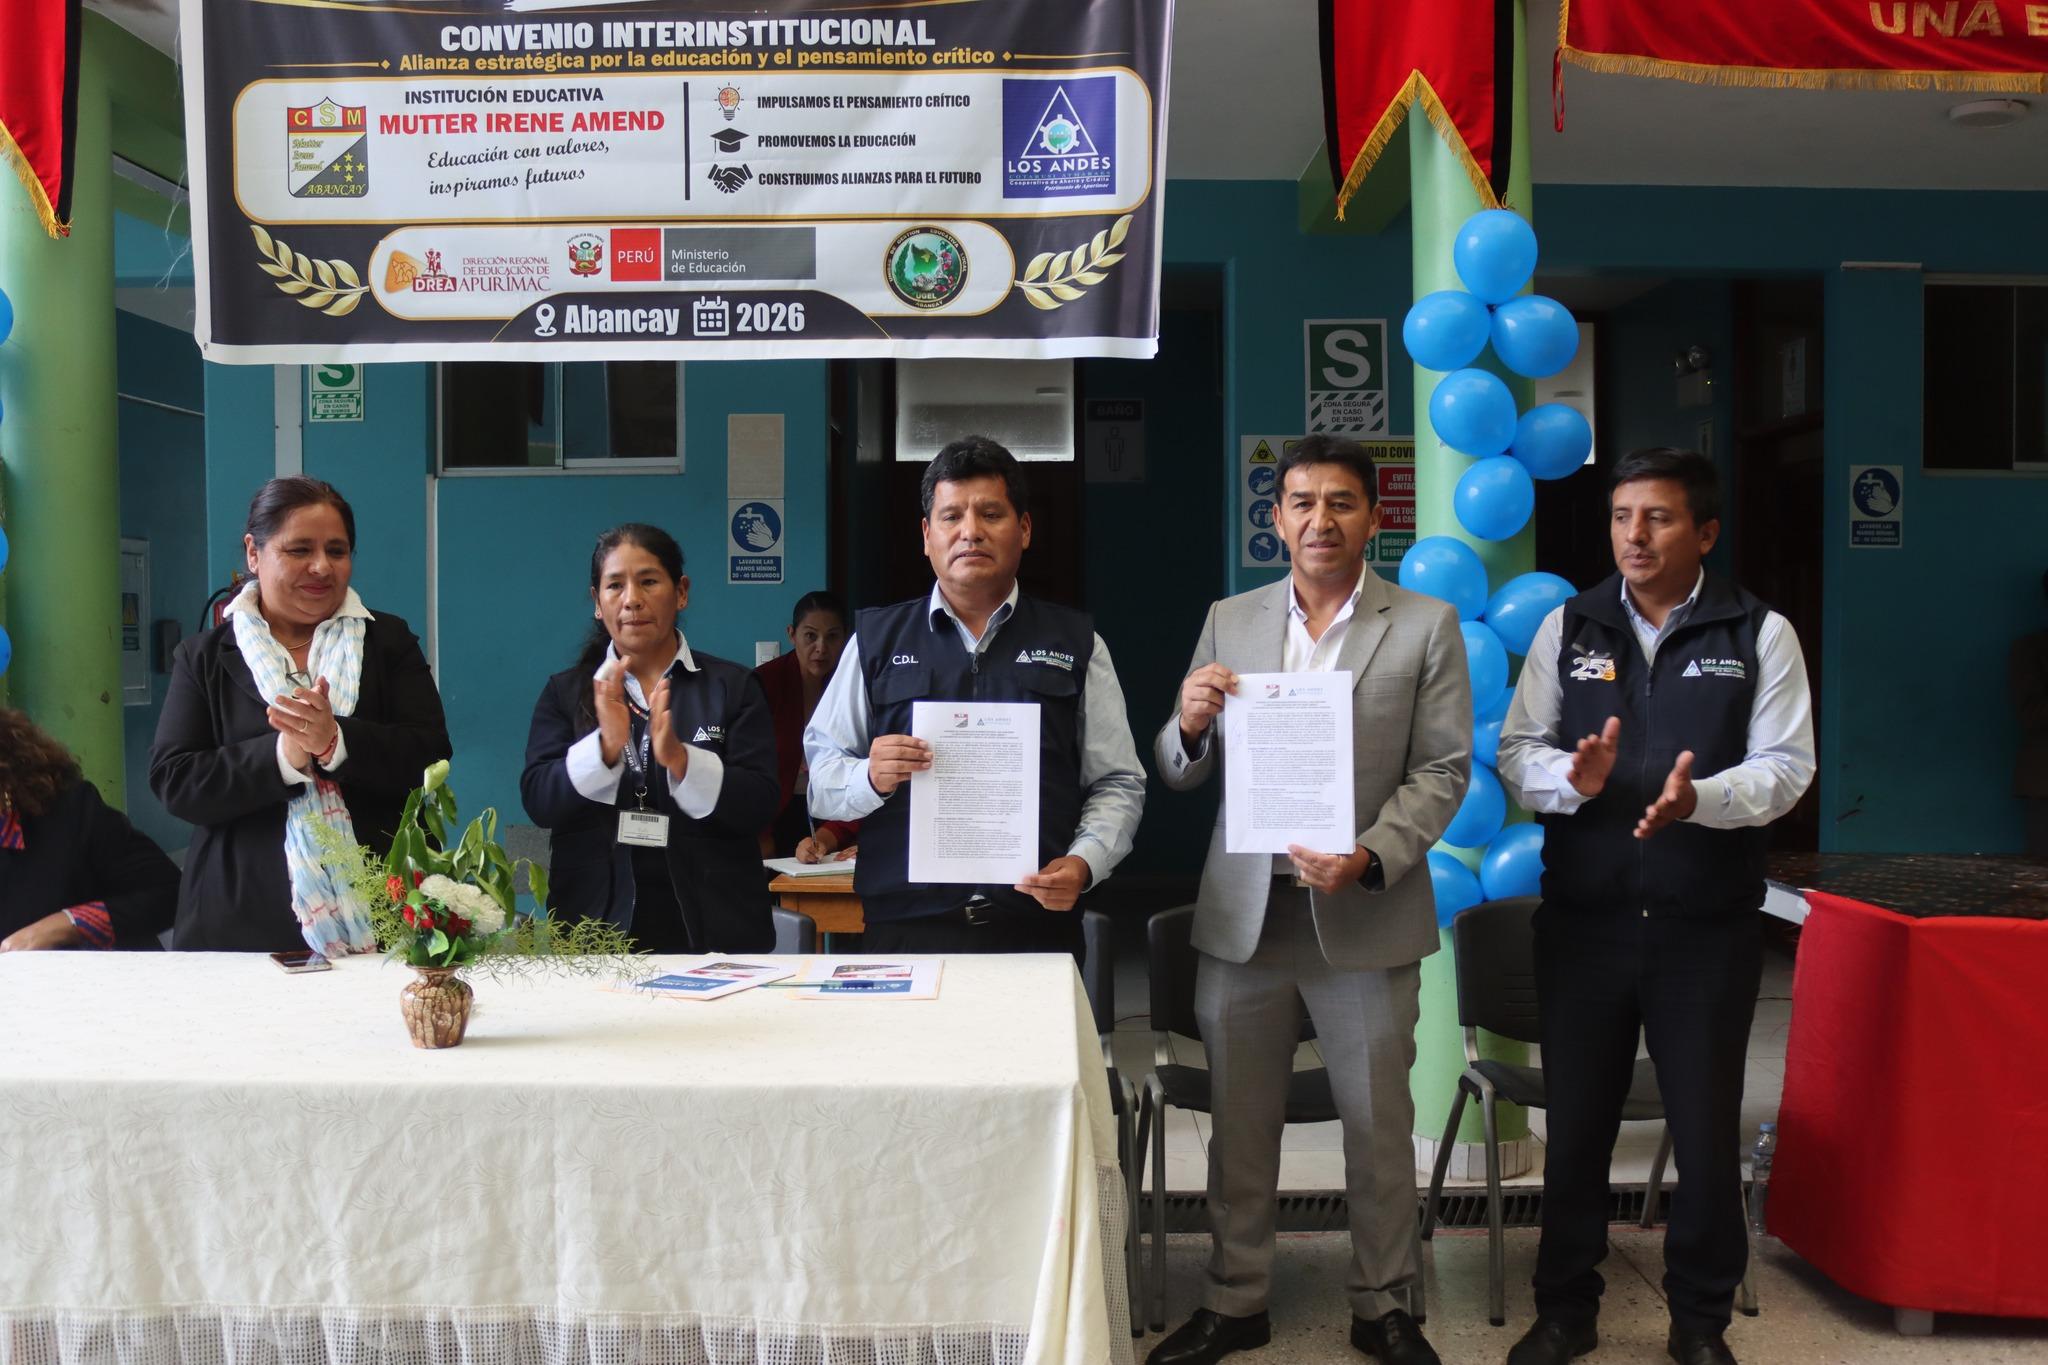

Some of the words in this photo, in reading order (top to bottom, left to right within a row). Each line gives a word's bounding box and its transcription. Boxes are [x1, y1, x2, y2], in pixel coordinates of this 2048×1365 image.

[1869, 0, 2004, 37] UNA
[2025, 4, 2048, 36] E
[441, 23, 593, 51] CONVENIO
[603, 19, 936, 48] INTERINSTITUCIONAL
[400, 54, 469, 71] Alianza
[475, 51, 585, 72] estratégica
[590, 55, 623, 71] por
[628, 51, 648, 67] la
[651, 48, 752, 67] educación
[757, 53, 768, 69] y
[774, 48, 792, 66] el
[797, 48, 927, 68] pensamiento
[932, 47, 995, 65] crítico
[405, 86, 507, 104] INSTITUCIÓN
[513, 88, 604, 103] EDUCATIVA
[757, 95, 831, 109] IMPULSAMOS
[833, 96, 845, 109] EL
[847, 95, 923, 109] PENSAMIENTO
[925, 92, 970, 108] CRÍTICO
[294, 110, 308, 126] C
[320, 103, 337, 126] S
[347, 109, 361, 125] M
[379, 113, 478, 135] MUTTER
[486, 112, 564, 133] IRENE
[571, 110, 665, 132] AMEND
[757, 135, 836, 148] PROMOVEMOS
[838, 135, 851, 148] LA
[853, 131, 916, 147] EDUCACIÓN
[427, 146, 509, 168] Educación
[513, 147, 540, 160] con
[546, 138, 609, 156] valores,
[1008, 160, 1042, 173] LOS
[1050, 157, 1111, 172] ANDES
[428, 175, 519, 197] inspiramos
[525, 167, 585, 190] futuros
[758, 172, 839, 186] CONSTRUIMOS
[841, 172, 892, 185] ALIANZAS
[895, 171, 923, 185] PARA
[926, 171, 937, 184] EL
[939, 171, 982, 185] FUTURO
[305, 184, 367, 196] ABANCAY
[463, 256, 507, 265] DIRECCIÓN
[509, 256, 549, 265] REGIONAL
[618, 248, 654, 263] PERÚ
[671, 249, 729, 260] Ministerio
[463, 267, 476, 275] DE
[478, 265, 534, 275] EDUCACIÓN
[537, 266, 550, 275] DE
[671, 262, 686, 273] de
[689, 261, 746, 273] Educación
[415, 278, 455, 291] DREA
[459, 275, 551, 292] APURÍMAC
[563, 305, 680, 336] Abancay
[736, 303, 805, 332] 2026
[1322, 329, 1371, 388] S
[1368, 446, 1387, 458] DAD
[1390, 446, 1415, 458] COVI
[1388, 482, 1415, 490] CONTAC
[1402, 515, 1416, 523] CAR
[892, 655, 919, 665] C.D.L.
[1049, 651, 1074, 662] ANDES
[1570, 657, 1604, 679] 25
